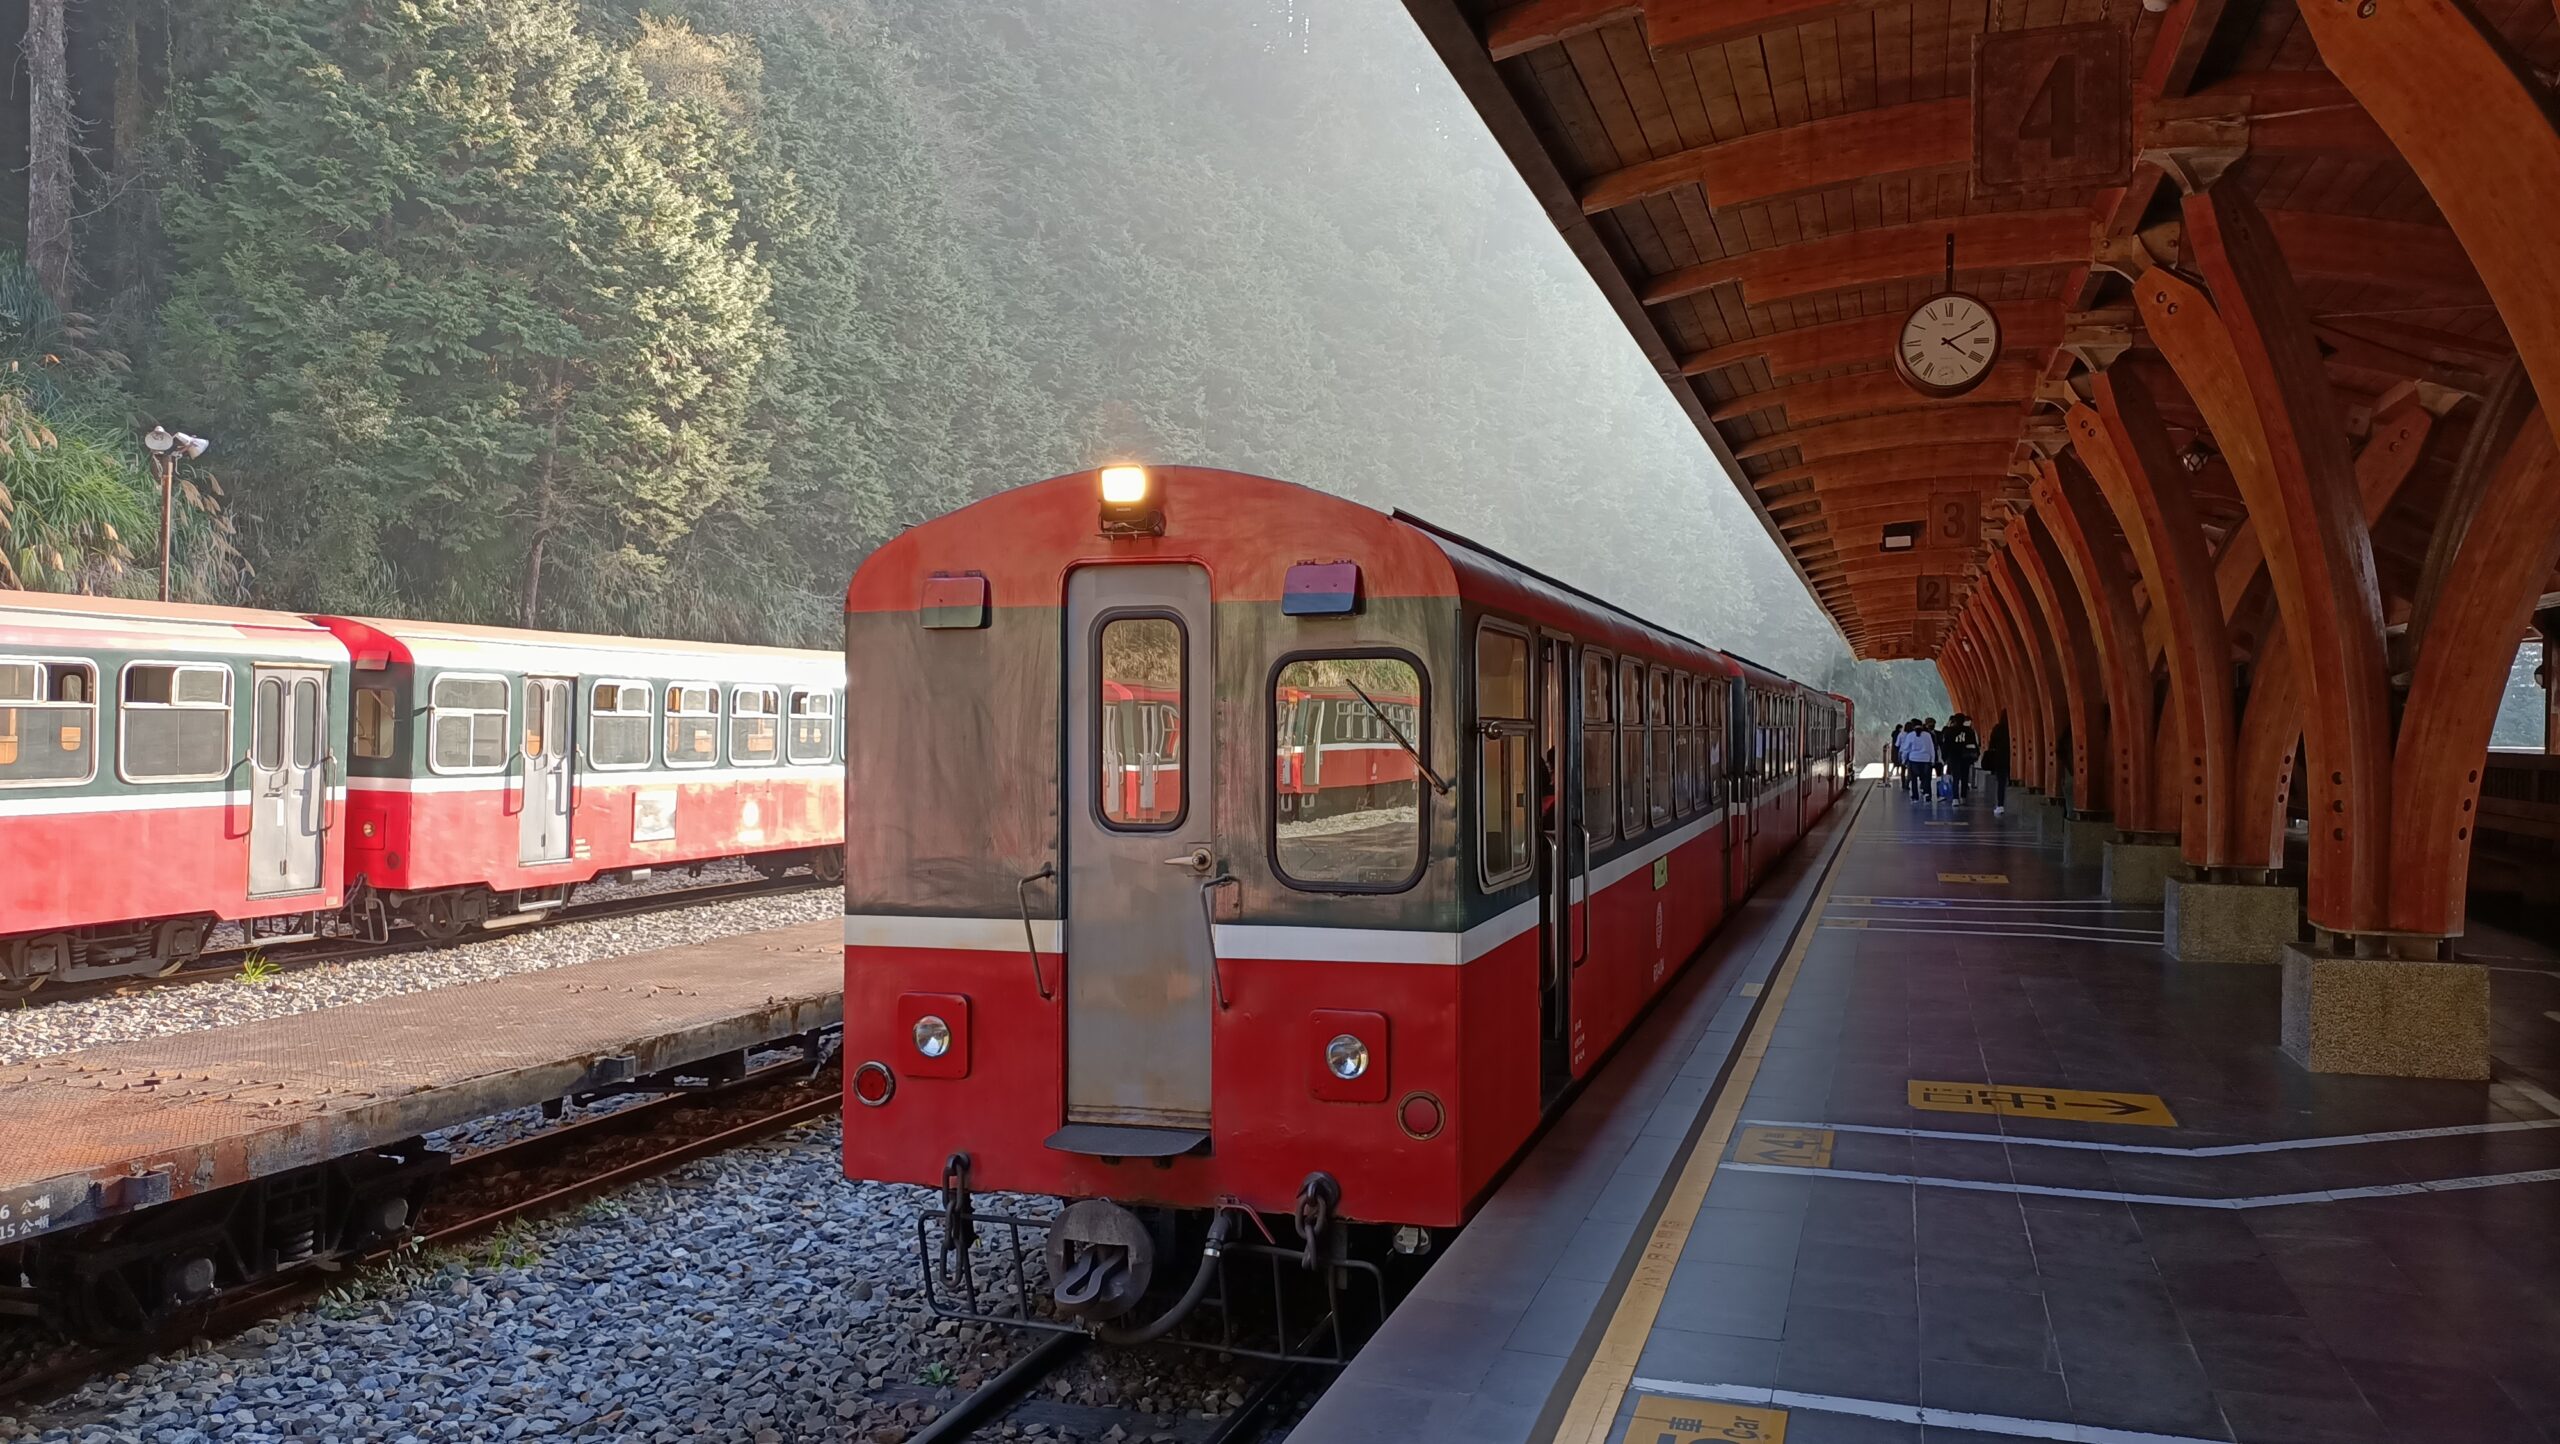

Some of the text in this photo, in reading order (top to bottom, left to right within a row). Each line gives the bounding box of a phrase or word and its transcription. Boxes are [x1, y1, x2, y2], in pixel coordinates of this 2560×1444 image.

[2019, 55, 2082, 158] 4
[1942, 501, 1967, 539] 3
[1925, 580, 1941, 604] 2
[1668, 1416, 1703, 1433] 車
[1722, 1415, 1761, 1440] Car
